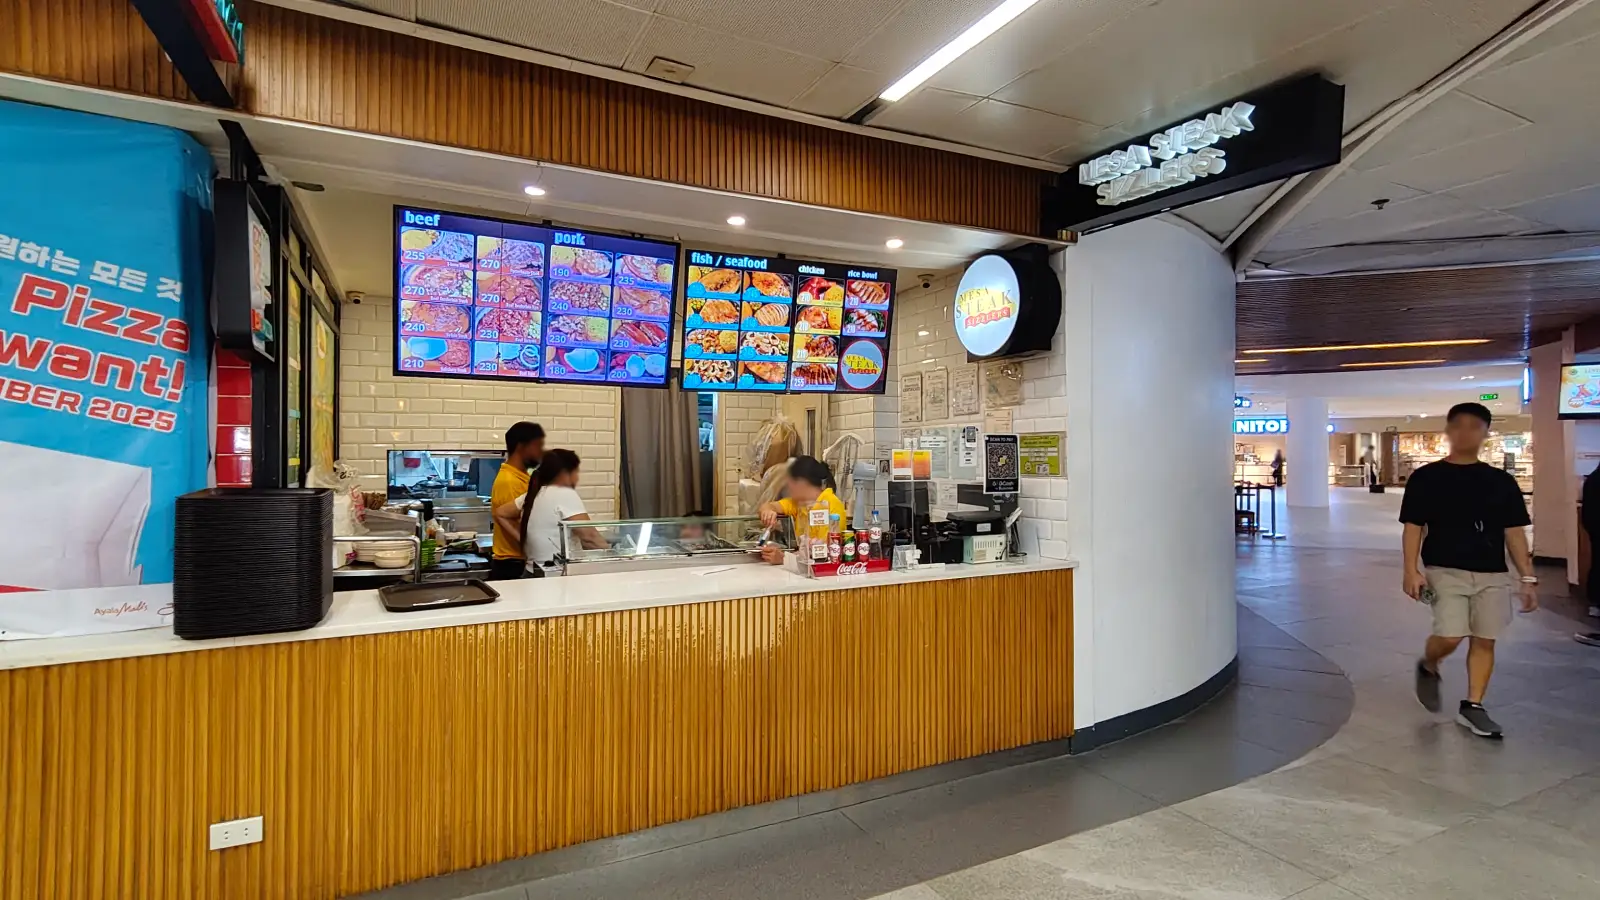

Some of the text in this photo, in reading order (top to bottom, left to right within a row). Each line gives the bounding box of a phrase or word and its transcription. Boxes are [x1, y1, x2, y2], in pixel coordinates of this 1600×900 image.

[1079, 101, 1256, 186] MESA STEAK
[1096, 147, 1226, 206] SIZZLERS
[405, 211, 441, 226] beef
[554, 232, 586, 245] pork
[405, 250, 425, 260] 255
[481, 259, 500, 269] 270
[691, 252, 767, 269] fish / seafood
[553, 267, 570, 277] 190
[798, 265, 825, 275] chicken
[847, 270, 878, 279] rice bowl
[89, 260, 148, 292] 모든
[156, 277, 183, 302] 것
[618, 276, 635, 285] 235
[404, 286, 425, 296] 270
[959, 286, 989, 303] MESA
[481, 294, 500, 303] 270
[551, 302, 569, 311] 240
[955, 289, 1012, 319] STEAK
[11, 273, 190, 353] Pizza
[616, 307, 633, 316] 230
[966, 308, 1008, 327] SIZZLERS
[405, 322, 426, 332] 240
[480, 330, 499, 339] 230
[549, 334, 566, 343] 230
[613, 339, 630, 348] 230
[0, 329, 186, 402] want!
[404, 359, 425, 369] 210
[479, 362, 498, 371] 230
[841, 359, 879, 369] STEAK
[550, 366, 566, 375] 180
[611, 371, 627, 379] 200
[86, 397, 177, 433] 2025
